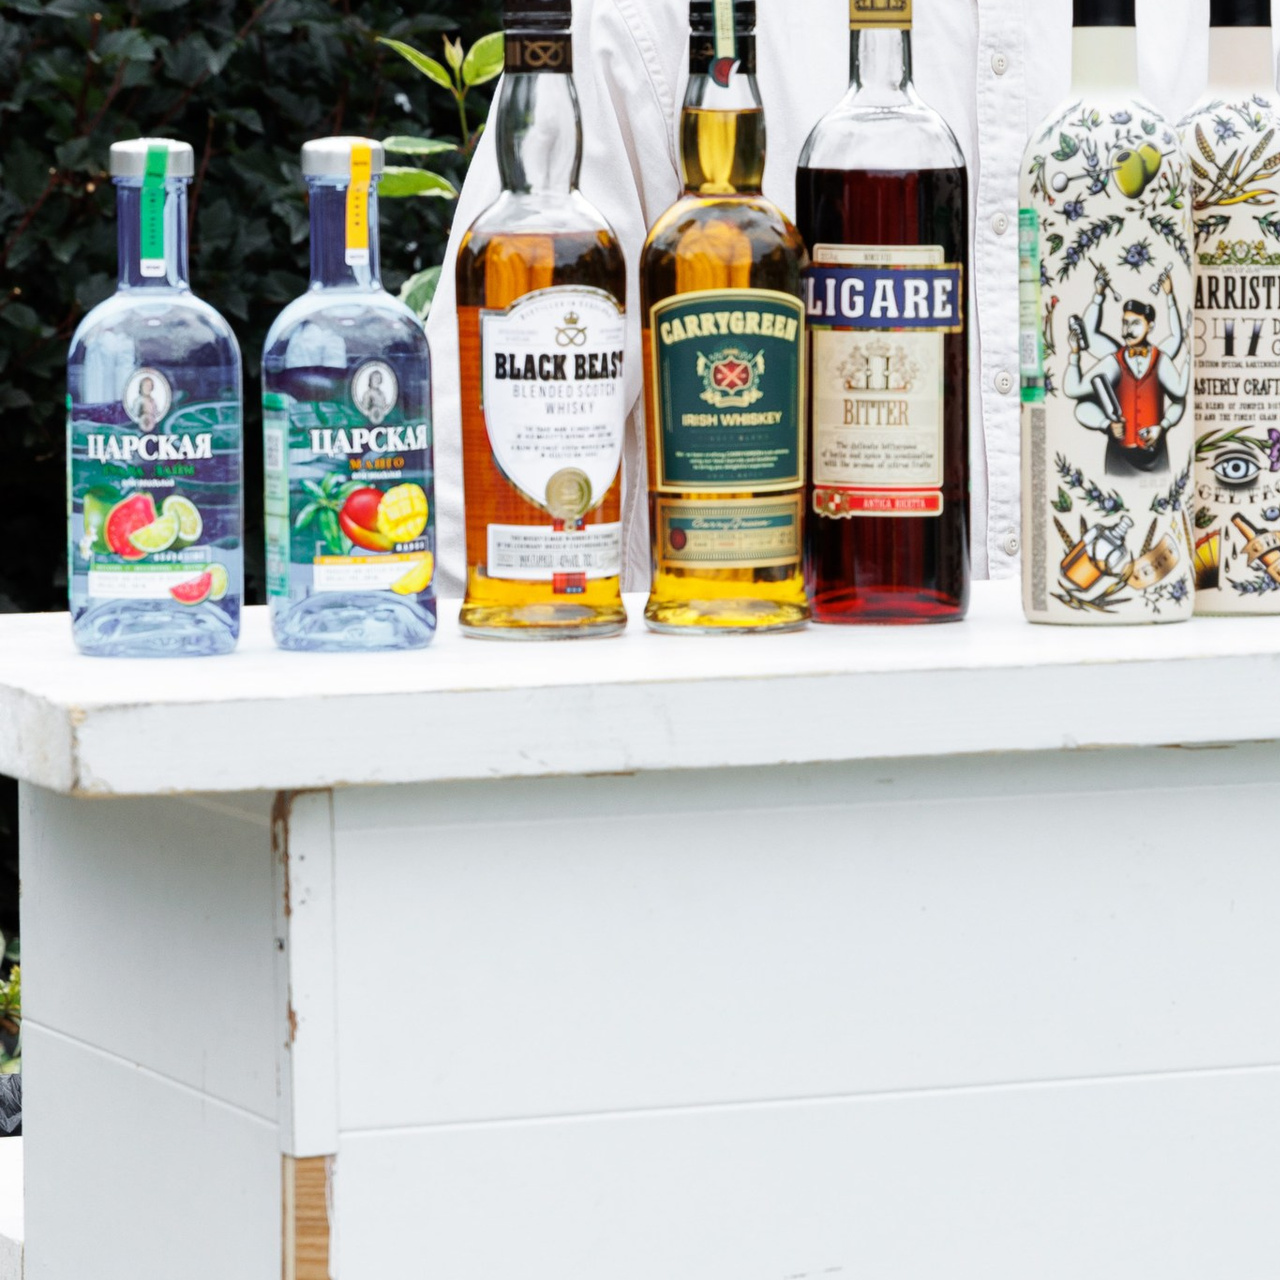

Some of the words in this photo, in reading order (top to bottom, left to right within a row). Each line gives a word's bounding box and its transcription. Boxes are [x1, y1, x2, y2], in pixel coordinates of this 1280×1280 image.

[806, 276, 953, 319] LIGARE
[660, 310, 798, 346] CARRYGREEN
[494, 353, 567, 381] BLACK
[513, 384, 574, 398] BLENDED
[1194, 377, 1240, 396] ASTERLY
[545, 402, 595, 415] WHISKY
[682, 412, 718, 427] IRISH
[720, 411, 782, 427] WHISKEY
[843, 399, 909, 426] BITTER
[86, 433, 213, 464] ЦАРСКАЯ
[310, 425, 428, 457] ЦАРСКАЯ
[1195, 482, 1242, 505] GEL
